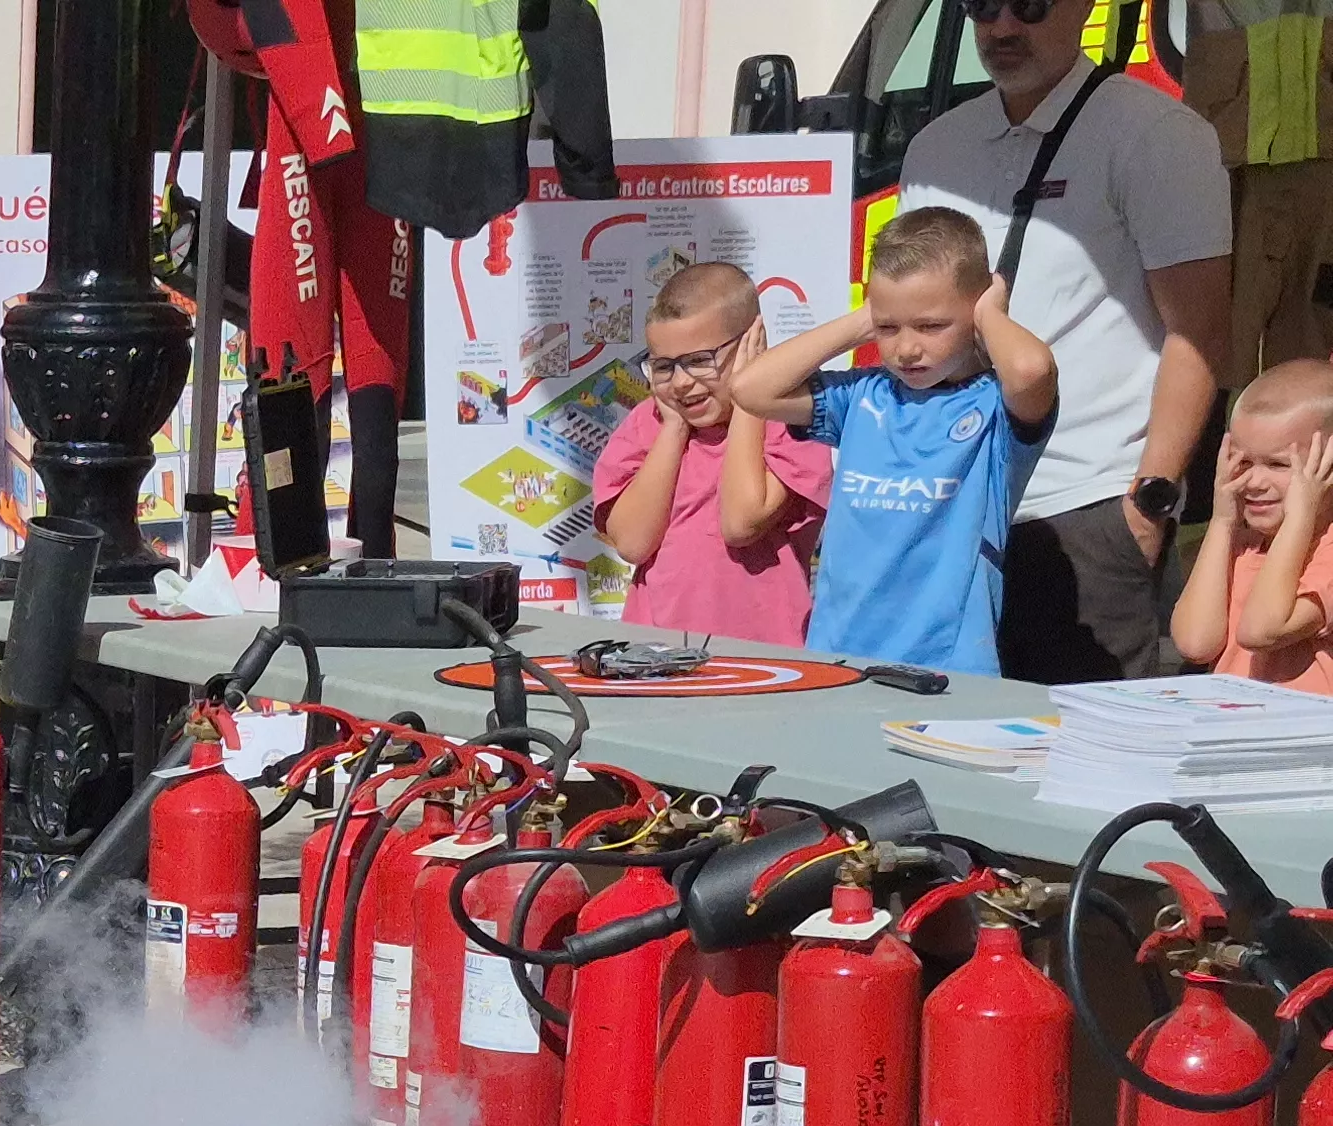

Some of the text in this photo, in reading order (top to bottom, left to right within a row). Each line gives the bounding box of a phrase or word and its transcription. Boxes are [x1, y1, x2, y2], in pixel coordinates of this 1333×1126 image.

[636, 176, 656, 196] de
[660, 175, 725, 196] Centros
[728, 174, 810, 195] Escolares
[280, 153, 318, 303] RESCATE
[388, 217, 410, 300] RESC
[842, 470, 962, 501] ETIHAD
[850, 498, 934, 514] AIRWAYS
